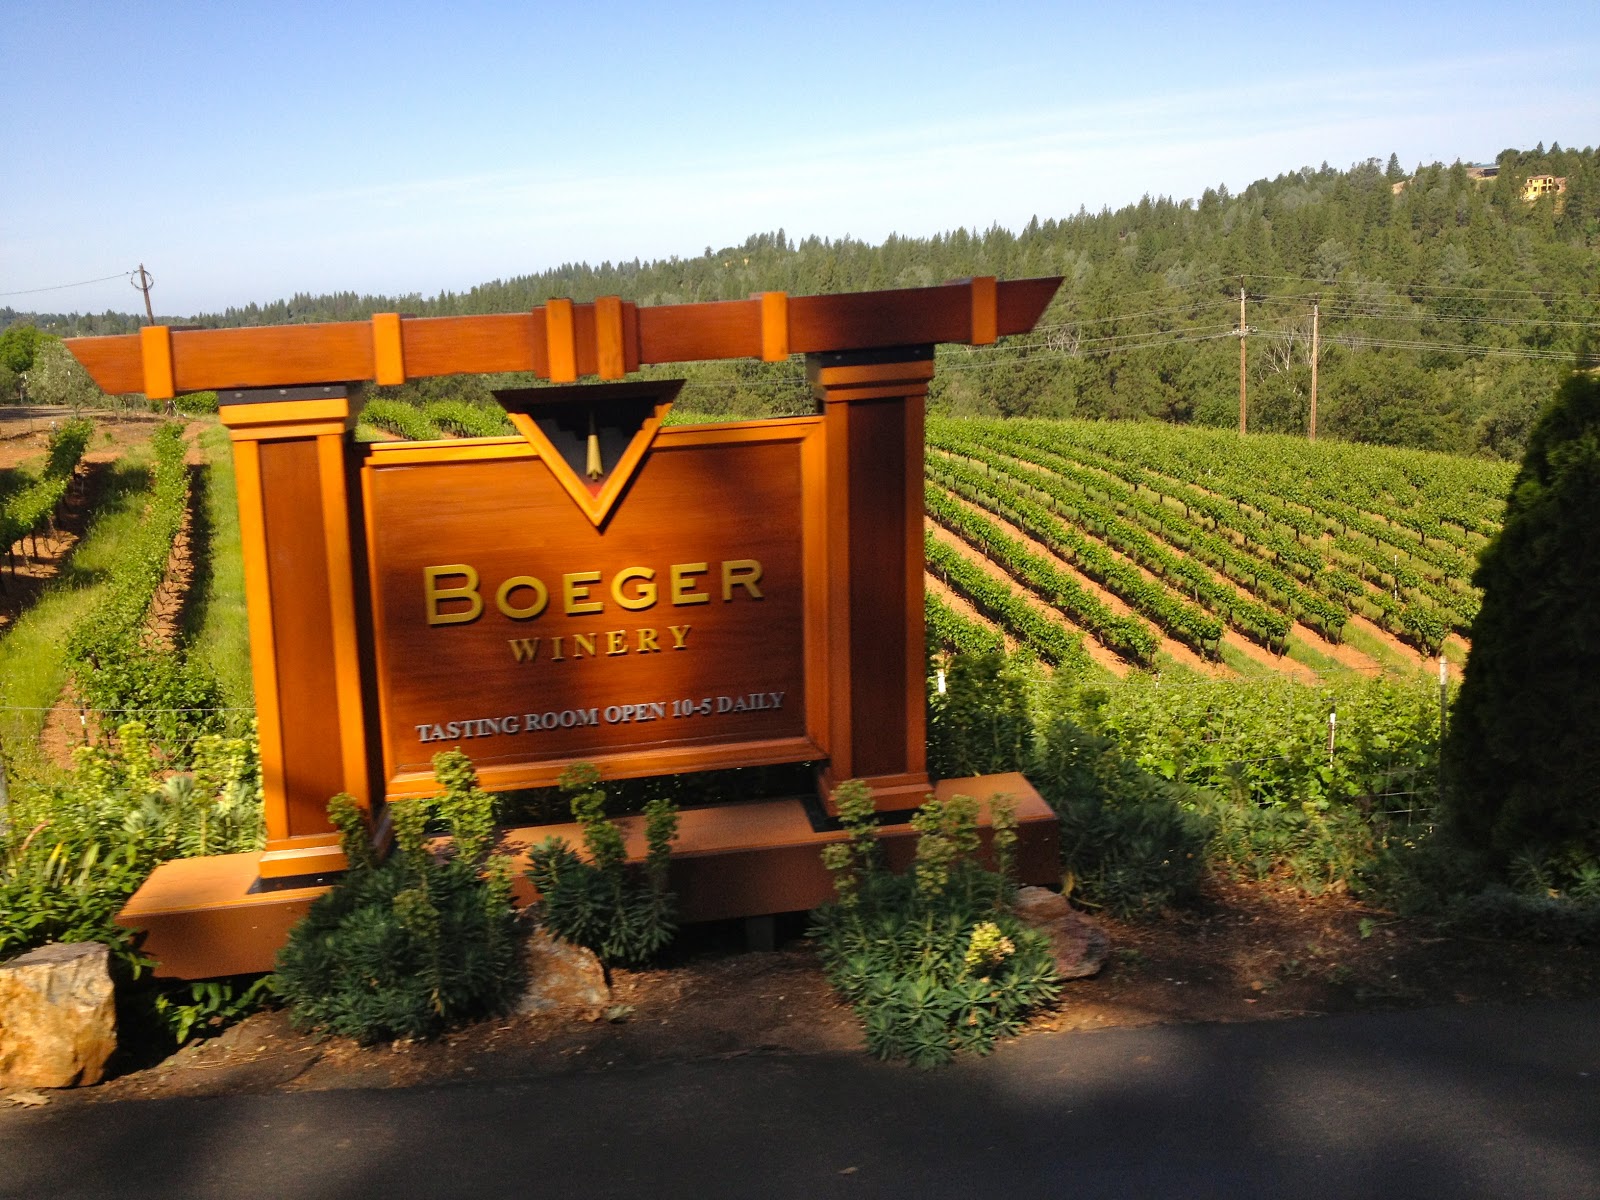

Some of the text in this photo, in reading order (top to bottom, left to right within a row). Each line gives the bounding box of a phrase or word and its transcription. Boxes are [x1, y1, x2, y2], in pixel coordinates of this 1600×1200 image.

[423, 558, 765, 626] BOEGER
[508, 624, 692, 662] WINERY
[415, 691, 785, 743] TASTING ROOM OPEN 10-5 DAILY
